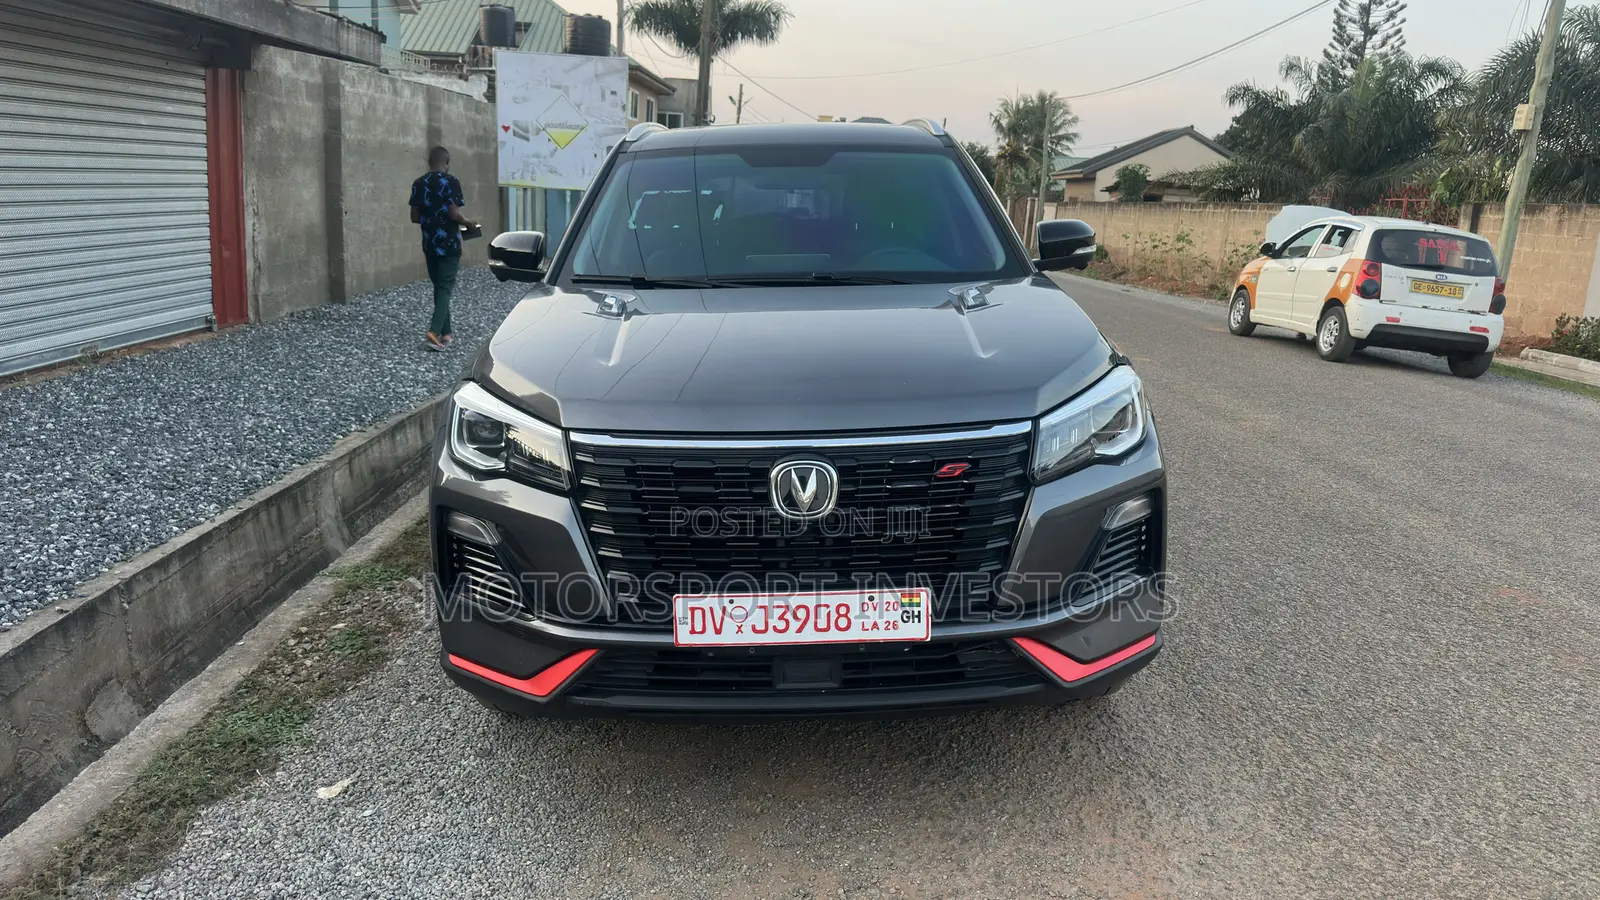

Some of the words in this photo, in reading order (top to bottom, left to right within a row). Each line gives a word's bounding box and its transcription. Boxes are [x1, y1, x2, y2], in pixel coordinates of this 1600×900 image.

[861, 601, 879, 613] DV
[884, 600, 900, 612] 20
[688, 605, 727, 635] DV
[751, 602, 851, 635] J3908
[900, 609, 921, 624] GH
[861, 620, 880, 632] LA
